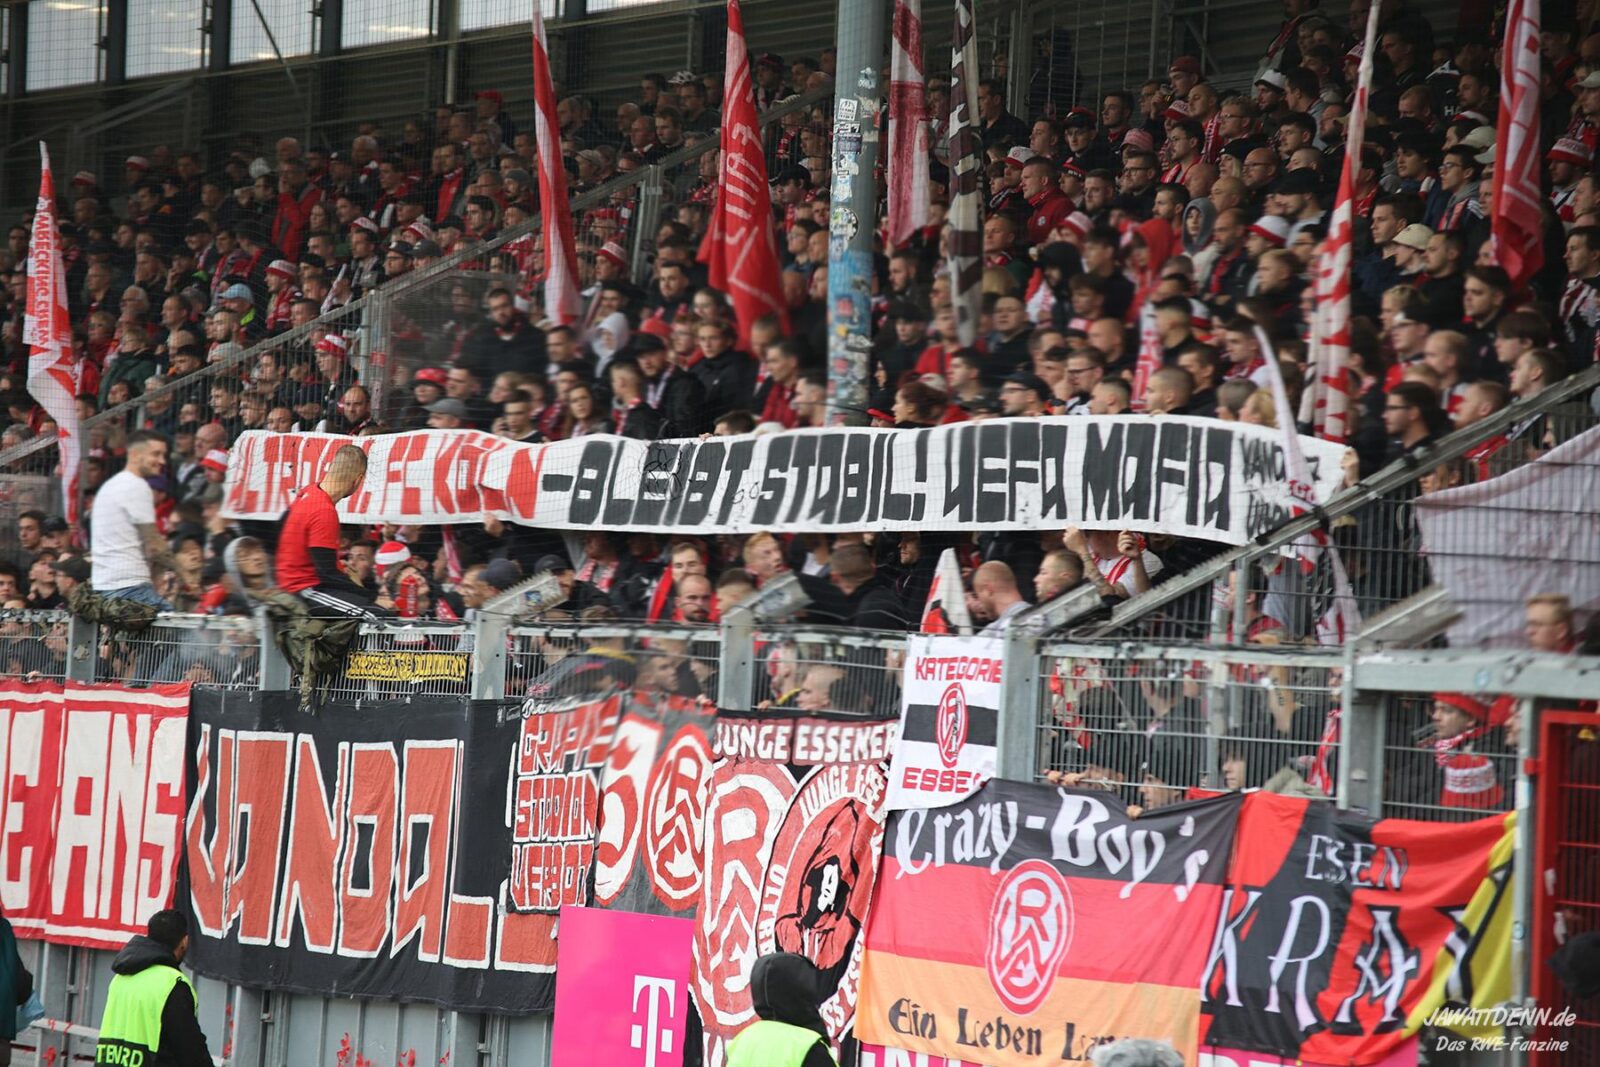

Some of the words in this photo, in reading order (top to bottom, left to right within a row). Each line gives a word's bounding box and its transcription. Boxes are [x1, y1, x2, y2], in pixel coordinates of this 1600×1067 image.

[943, 421, 1068, 523] UEFA
[1082, 422, 1234, 532] MAFIA
[915, 655, 1004, 684] KATEGORIE
[713, 722, 791, 760] JUNGE
[513, 769, 599, 842] STADION
[510, 840, 594, 911] VERBOT
[888, 998, 938, 1040] Ein
[956, 1008, 1043, 1056] Leben
